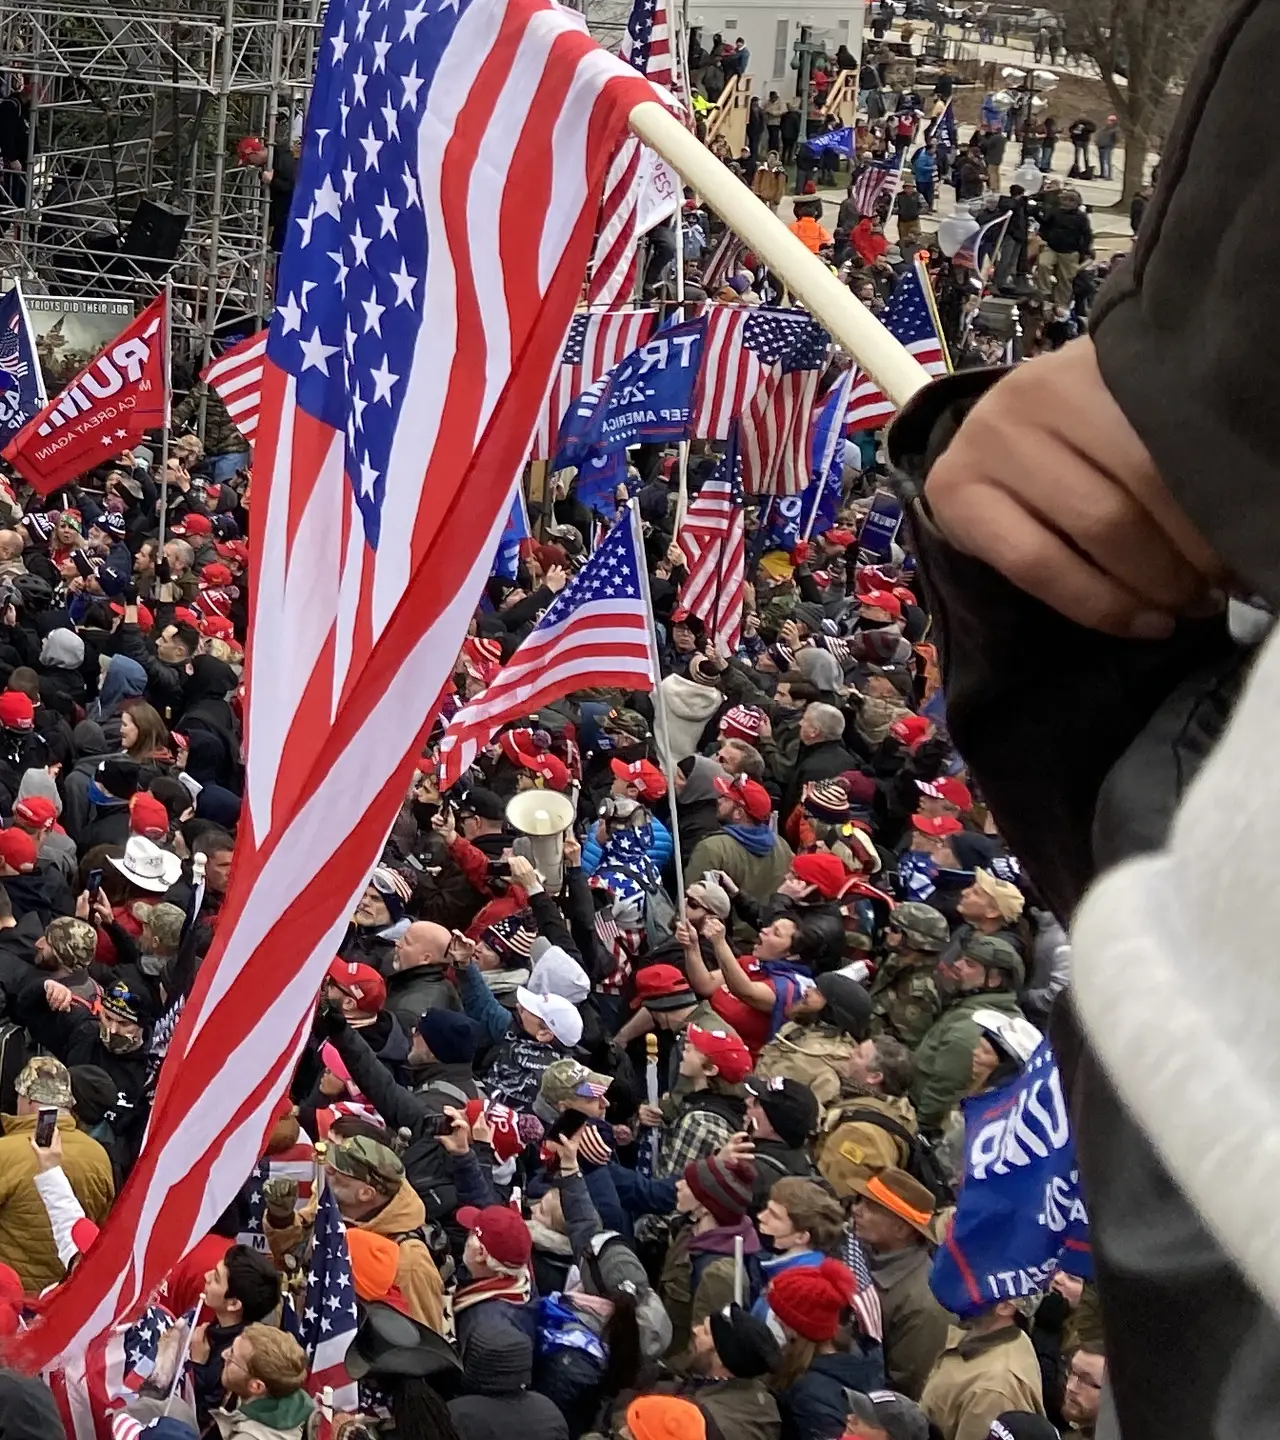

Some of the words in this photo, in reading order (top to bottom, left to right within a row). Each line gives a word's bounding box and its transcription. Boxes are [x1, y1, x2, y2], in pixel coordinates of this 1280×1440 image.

[25, 300, 61, 312] ATRIOTS
[63, 301, 80, 312] DID
[82, 302, 108, 313] THEIR
[110, 303, 130, 315] JOB
